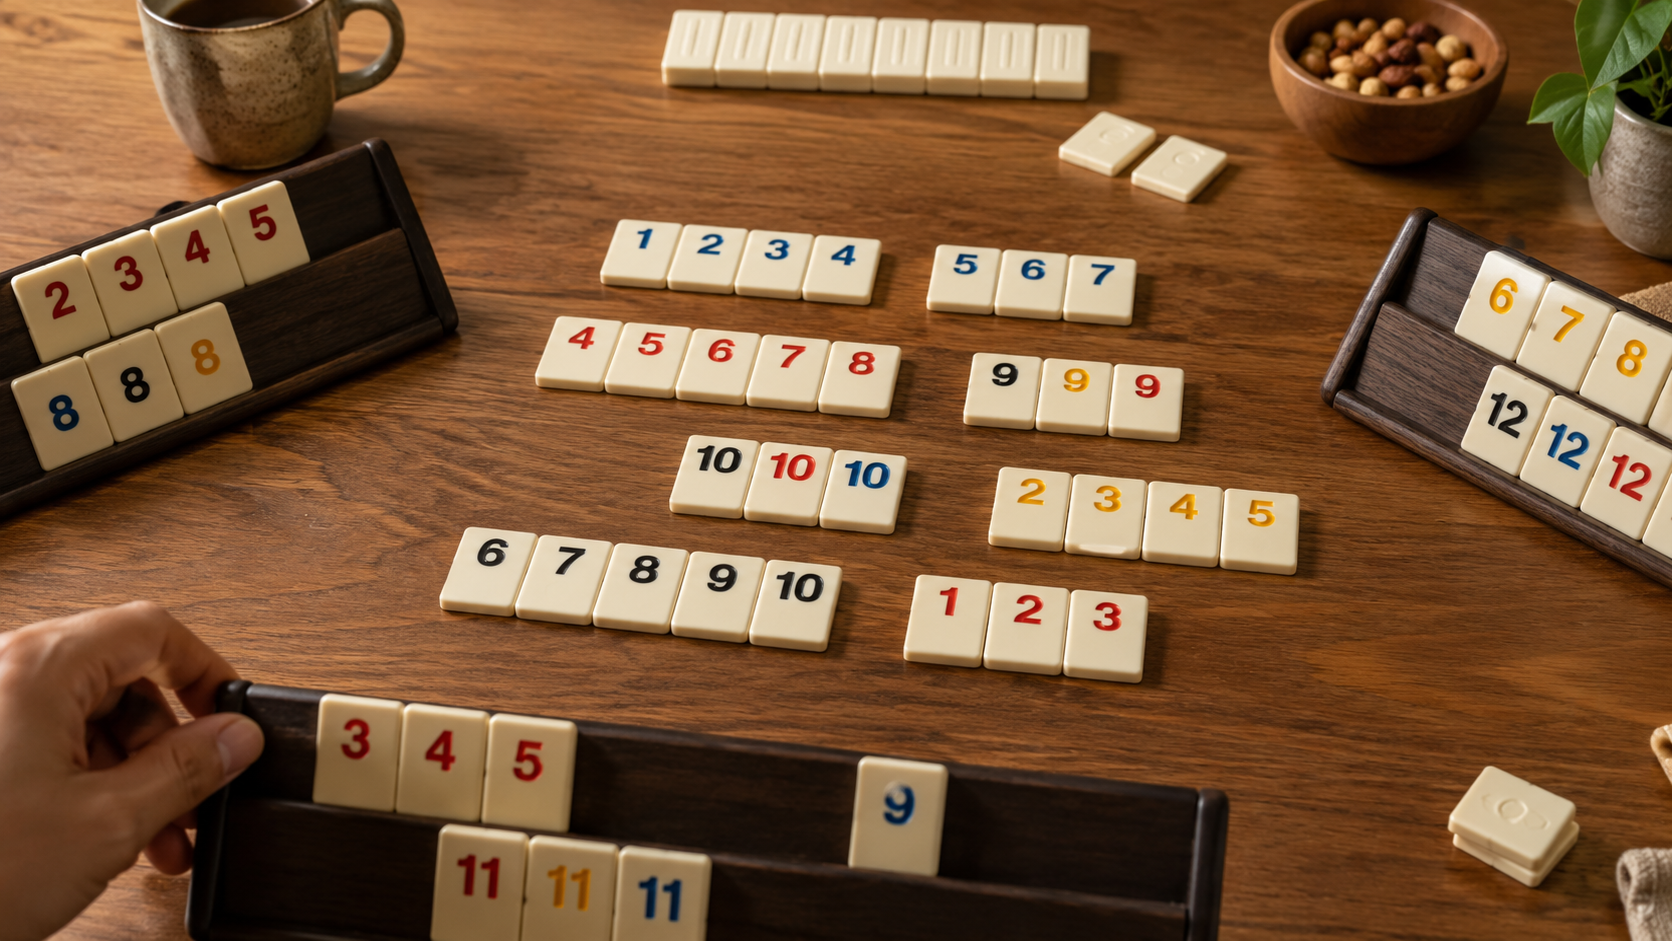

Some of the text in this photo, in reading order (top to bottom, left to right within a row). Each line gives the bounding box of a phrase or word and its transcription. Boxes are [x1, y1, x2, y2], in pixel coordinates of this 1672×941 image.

[45, 204, 277, 320] 2 3 4 5
[637, 228, 856, 266] 1 2 3 4
[953, 253, 1115, 285] 5 6 7
[568, 326, 875, 375] 4 5 6 7 8
[1489, 278, 1647, 377] 6 7 8
[49, 340, 220, 431] 8 8 8
[992, 363, 1160, 398] 9 9 9
[697, 445, 890, 489] 10 10 10
[1488, 392, 1652, 502] 12 12 12
[1017, 478, 1275, 527] 2 3 4 5
[477, 538, 824, 603] 6 7 8 9 10
[940, 587, 1121, 631] 1 2 3
[340, 719, 543, 782] 3 4 5
[883, 782, 915, 826] 9
[457, 855, 682, 922] 11 11 11
